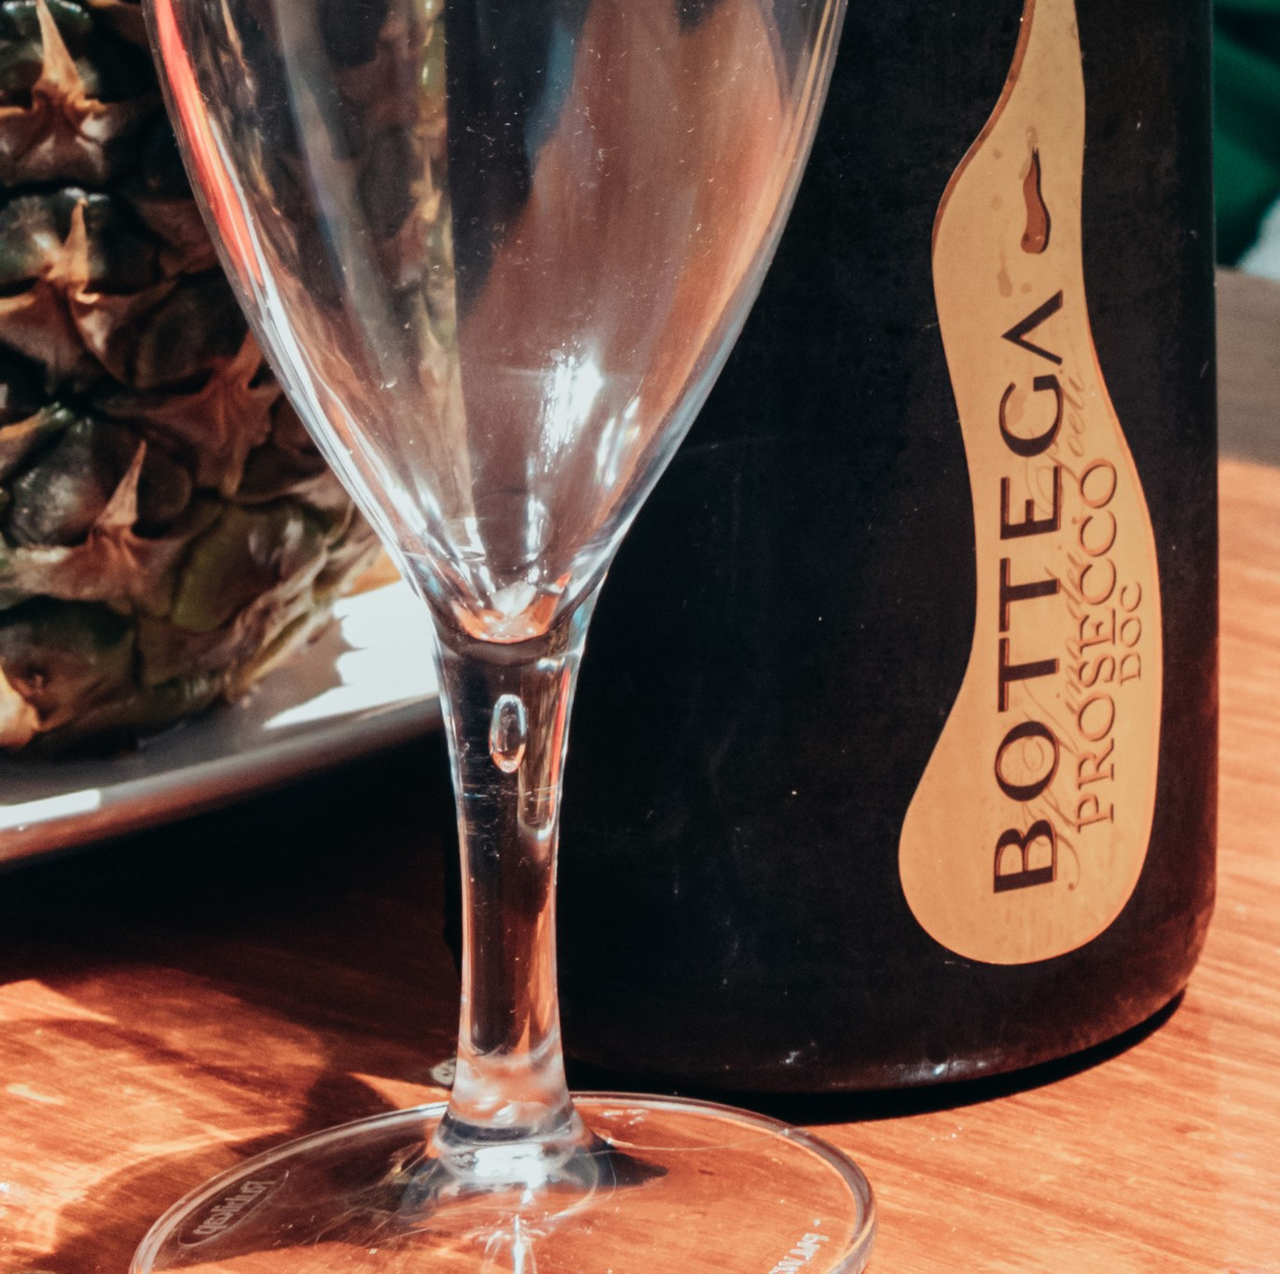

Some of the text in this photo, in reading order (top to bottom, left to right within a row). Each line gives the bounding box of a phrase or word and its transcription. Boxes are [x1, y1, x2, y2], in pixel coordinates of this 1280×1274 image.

[993, 288, 1064, 894] BOTTEGA
[1076, 458, 1118, 833] PROSECCO
[1118, 582, 1142, 686] DOC
